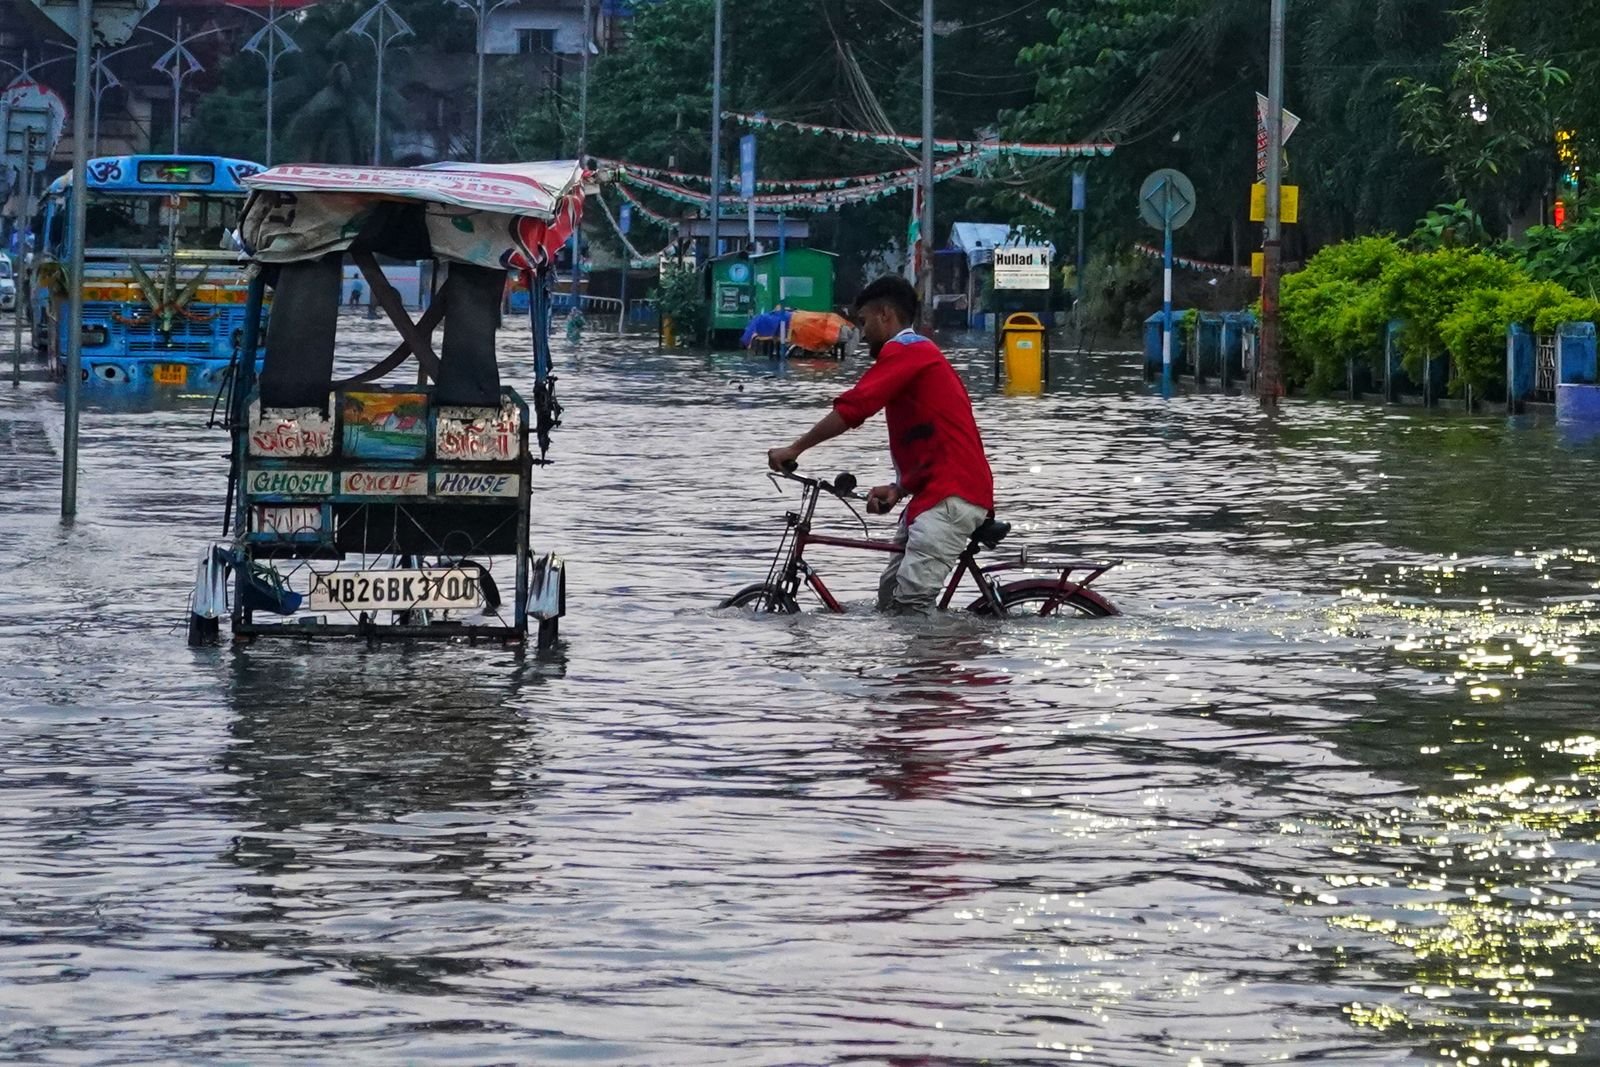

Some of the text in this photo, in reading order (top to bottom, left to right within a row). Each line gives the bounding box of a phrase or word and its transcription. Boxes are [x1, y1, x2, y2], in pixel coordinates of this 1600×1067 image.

[253, 471, 329, 493] GHOSH
[441, 473, 510, 492] HOUSE
[328, 577, 475, 603] WB26BK3700
